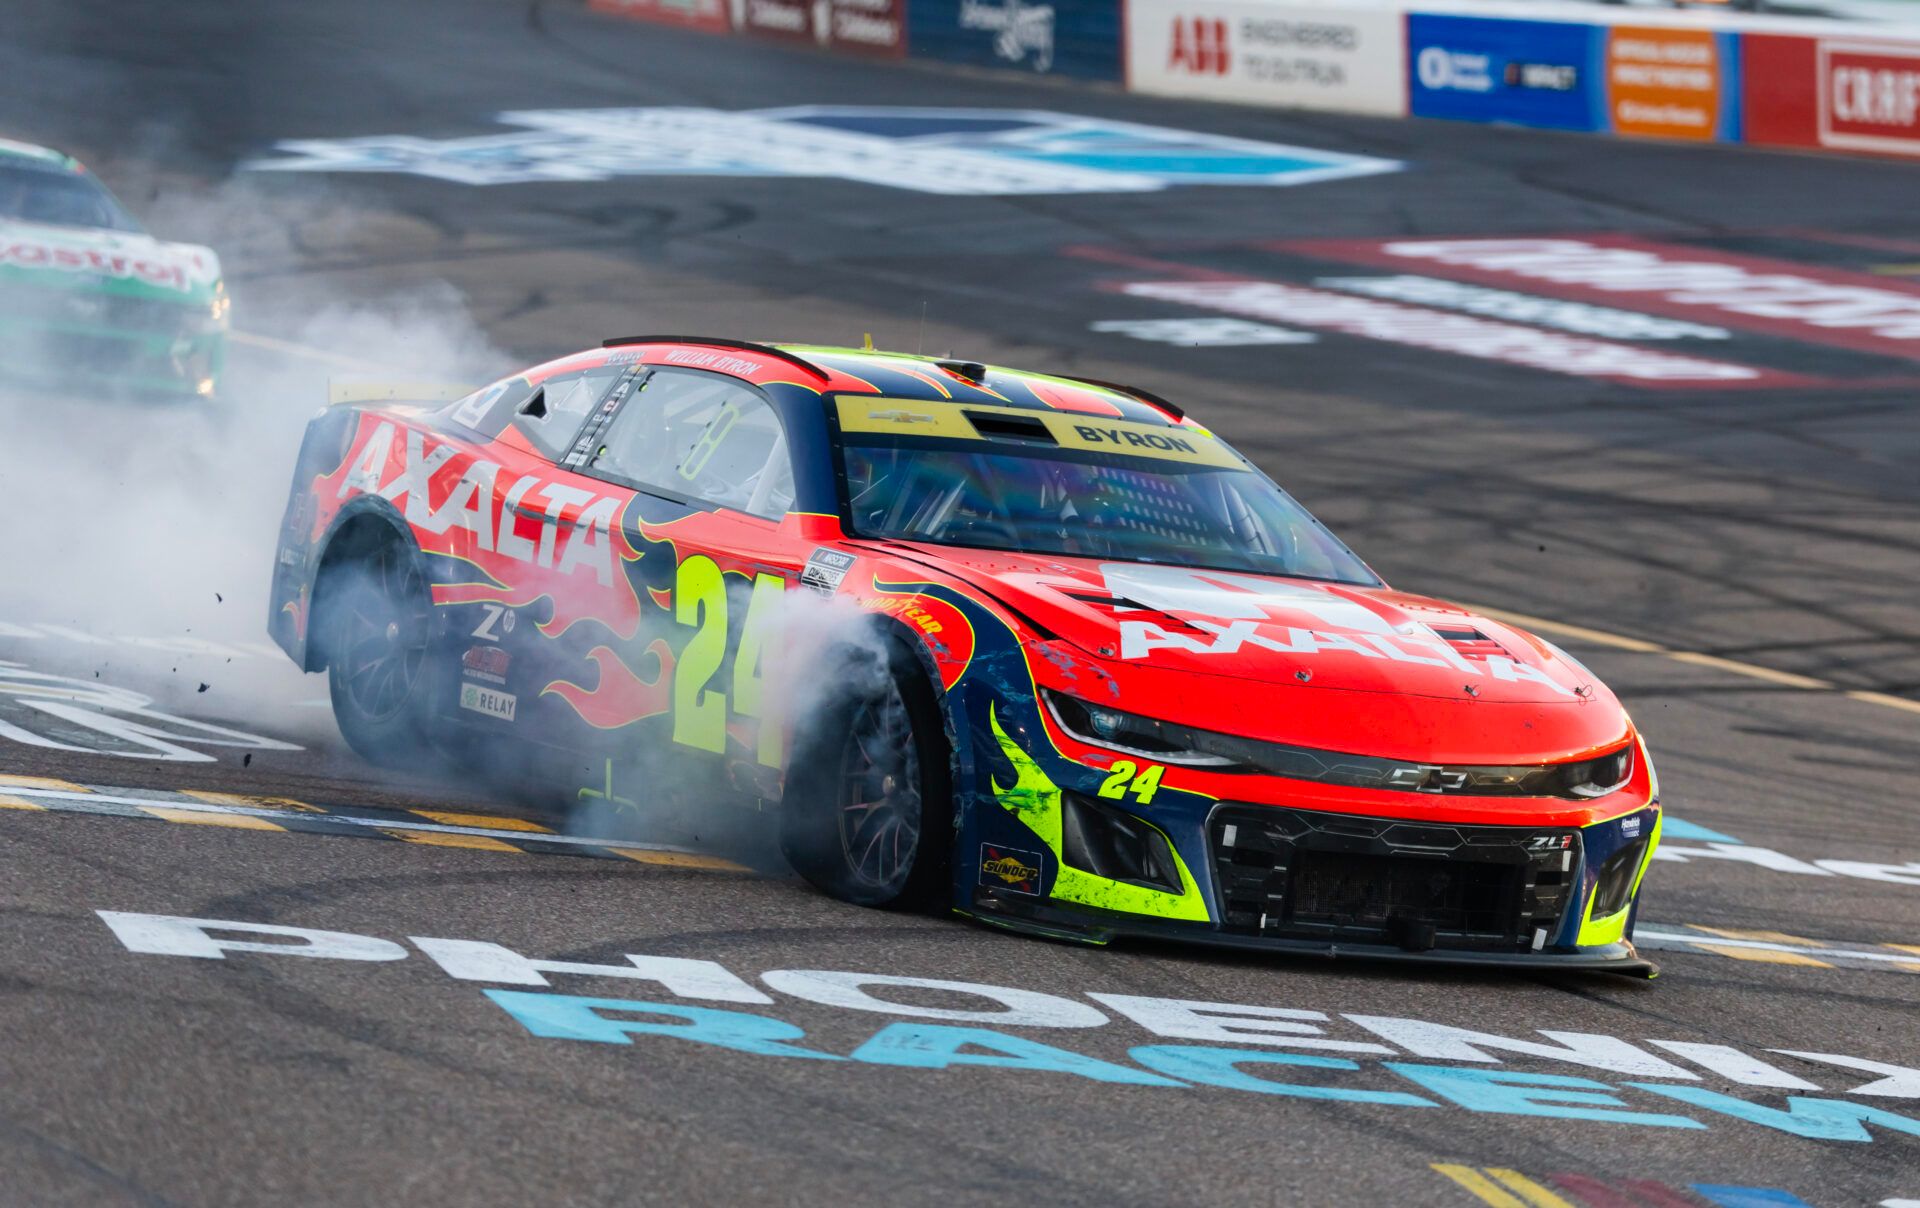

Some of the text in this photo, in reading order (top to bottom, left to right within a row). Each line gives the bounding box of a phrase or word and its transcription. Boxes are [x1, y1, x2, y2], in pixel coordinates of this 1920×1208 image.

[1167, 16, 1230, 76] ABB
[663, 350, 715, 366] WILLIAM
[715, 353, 762, 375] BYRON
[1073, 425, 1198, 454] BYRON
[336, 421, 623, 588] AXALTA
[672, 554, 786, 770] 24
[1119, 619, 1575, 697] AXALTA
[480, 693, 514, 715] RELAY
[1097, 760, 1166, 804] 24
[1527, 834, 1573, 850] ZL1
[983, 859, 1038, 880] SUNOCO
